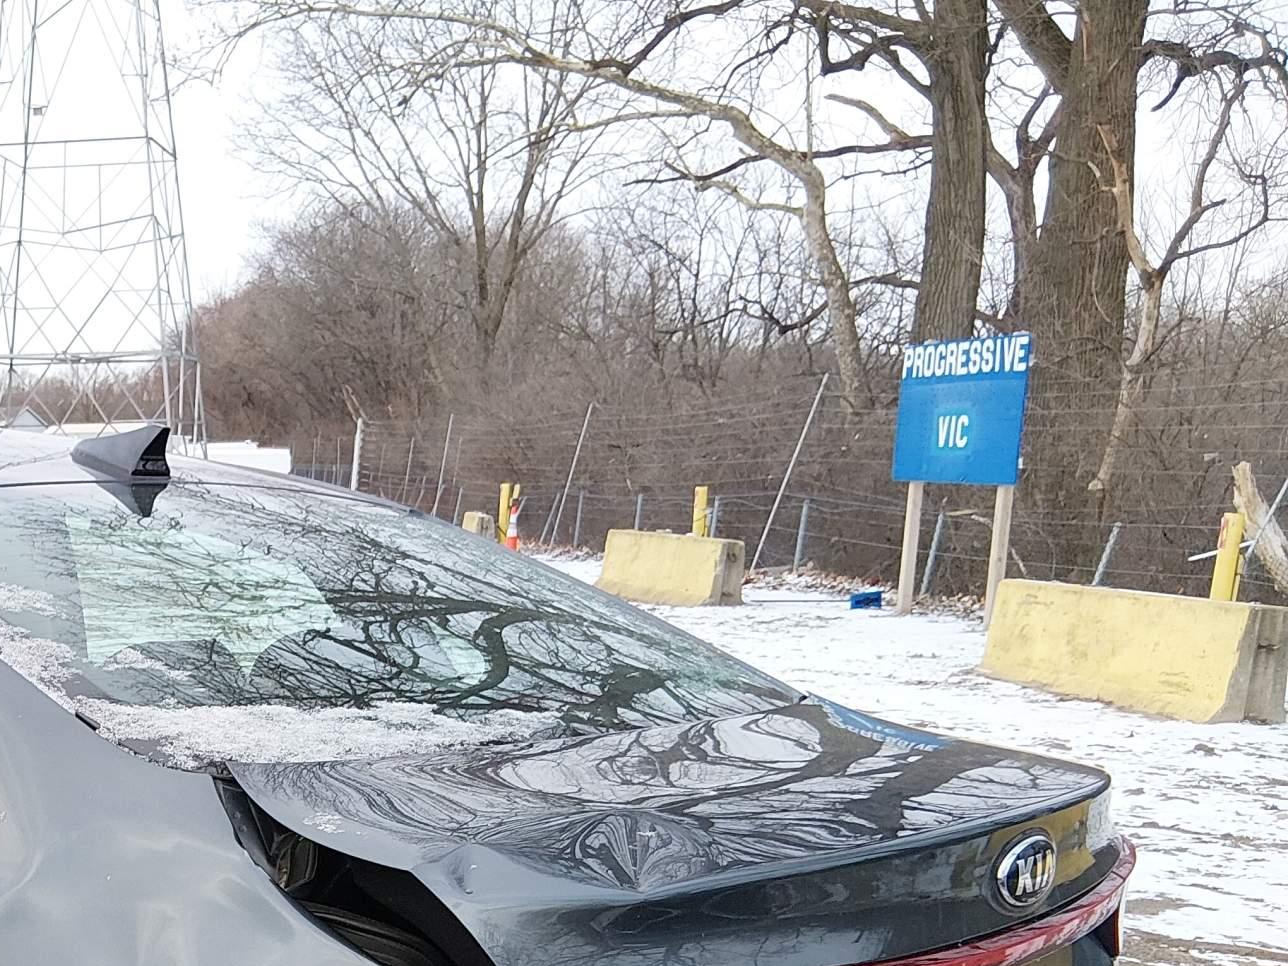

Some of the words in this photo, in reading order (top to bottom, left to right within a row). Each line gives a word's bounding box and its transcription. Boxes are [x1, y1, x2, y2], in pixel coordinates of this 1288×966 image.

[902, 336, 1029, 379] PROGRESSIVE
[938, 414, 969, 449] VIC
[1014, 848, 1054, 896] KIA
